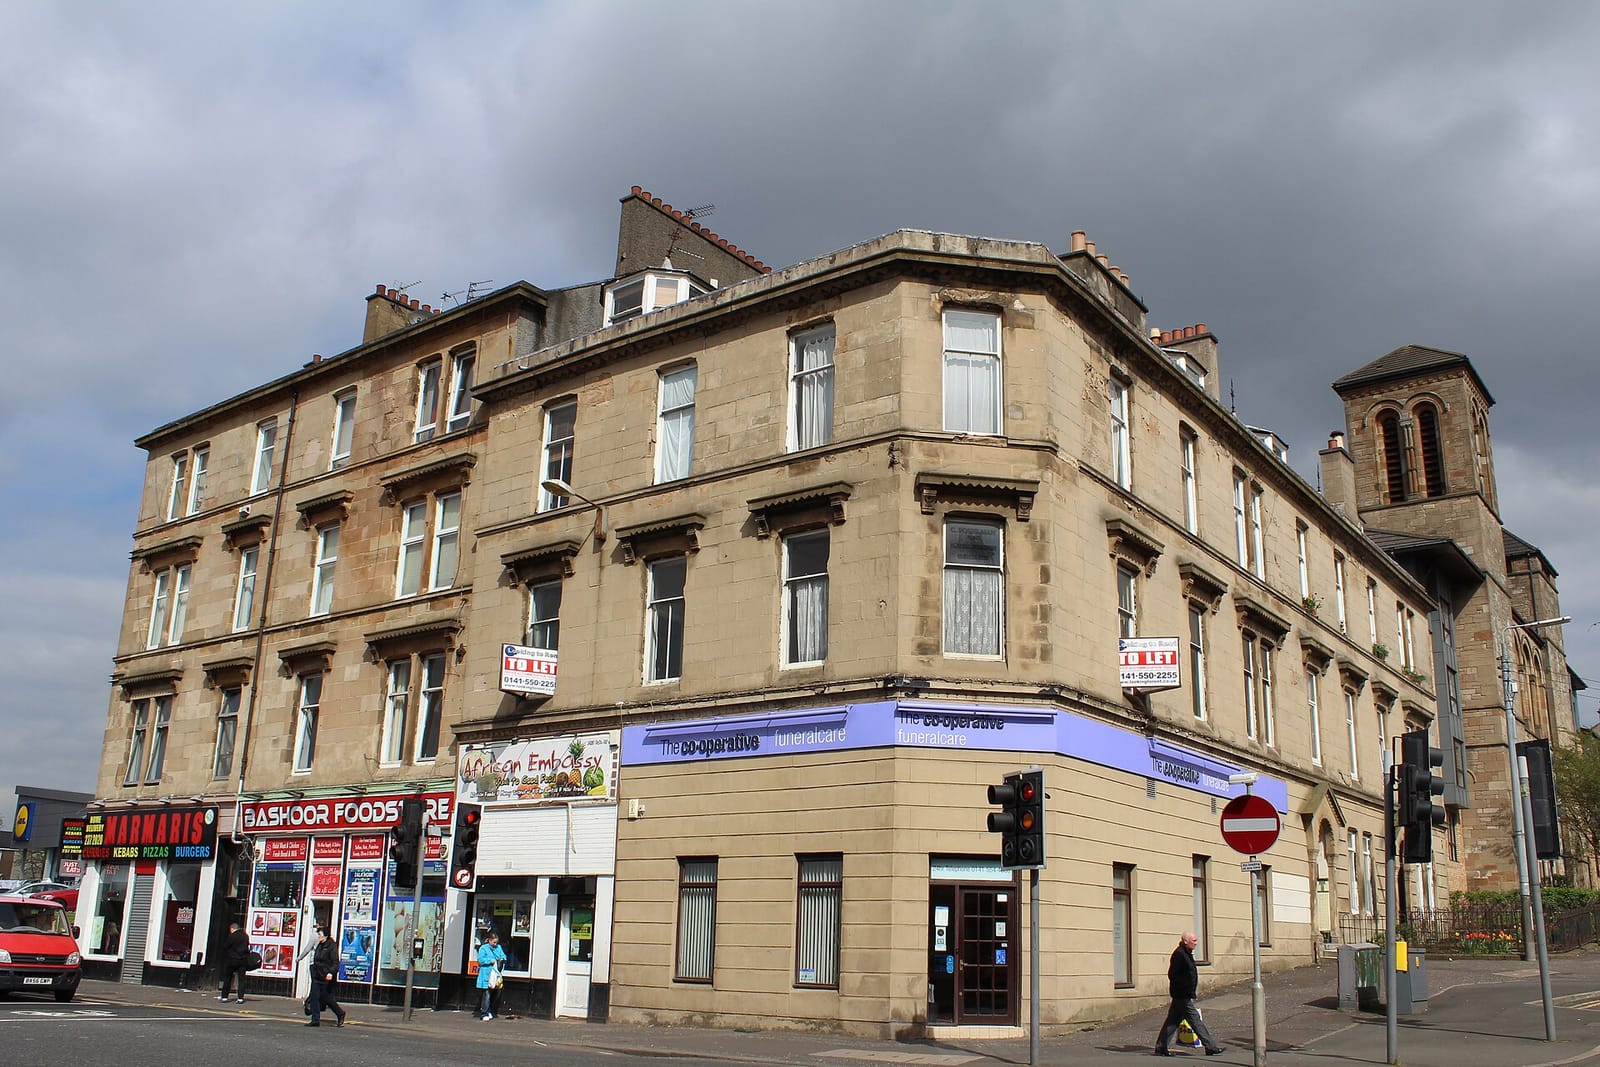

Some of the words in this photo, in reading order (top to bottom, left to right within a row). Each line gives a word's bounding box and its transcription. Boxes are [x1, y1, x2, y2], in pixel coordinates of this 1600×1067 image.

[507, 658, 528, 671] TO
[532, 660, 557, 674] LET
[1119, 652, 1139, 665] TO
[1146, 652, 1174, 664] LET
[1121, 672, 1178, 680] 141-550-2255
[900, 711, 920, 724] The
[922, 712, 1005, 730] co-operative
[662, 739, 680, 756] The
[680, 733, 760, 758] co-operative
[774, 726, 847, 748] funeralcare
[897, 728, 967, 746] funeralcare
[462, 758, 521, 777] African
[528, 750, 603, 775] Embassy
[244, 804, 330, 828] BASHOOR
[334, 798, 450, 824] FOODSRE
[104, 811, 204, 845] MARMARIS
[113, 846, 138, 858] KEBABS
[142, 846, 169, 858] PIZZAS
[176, 846, 210, 858] BURGERS
